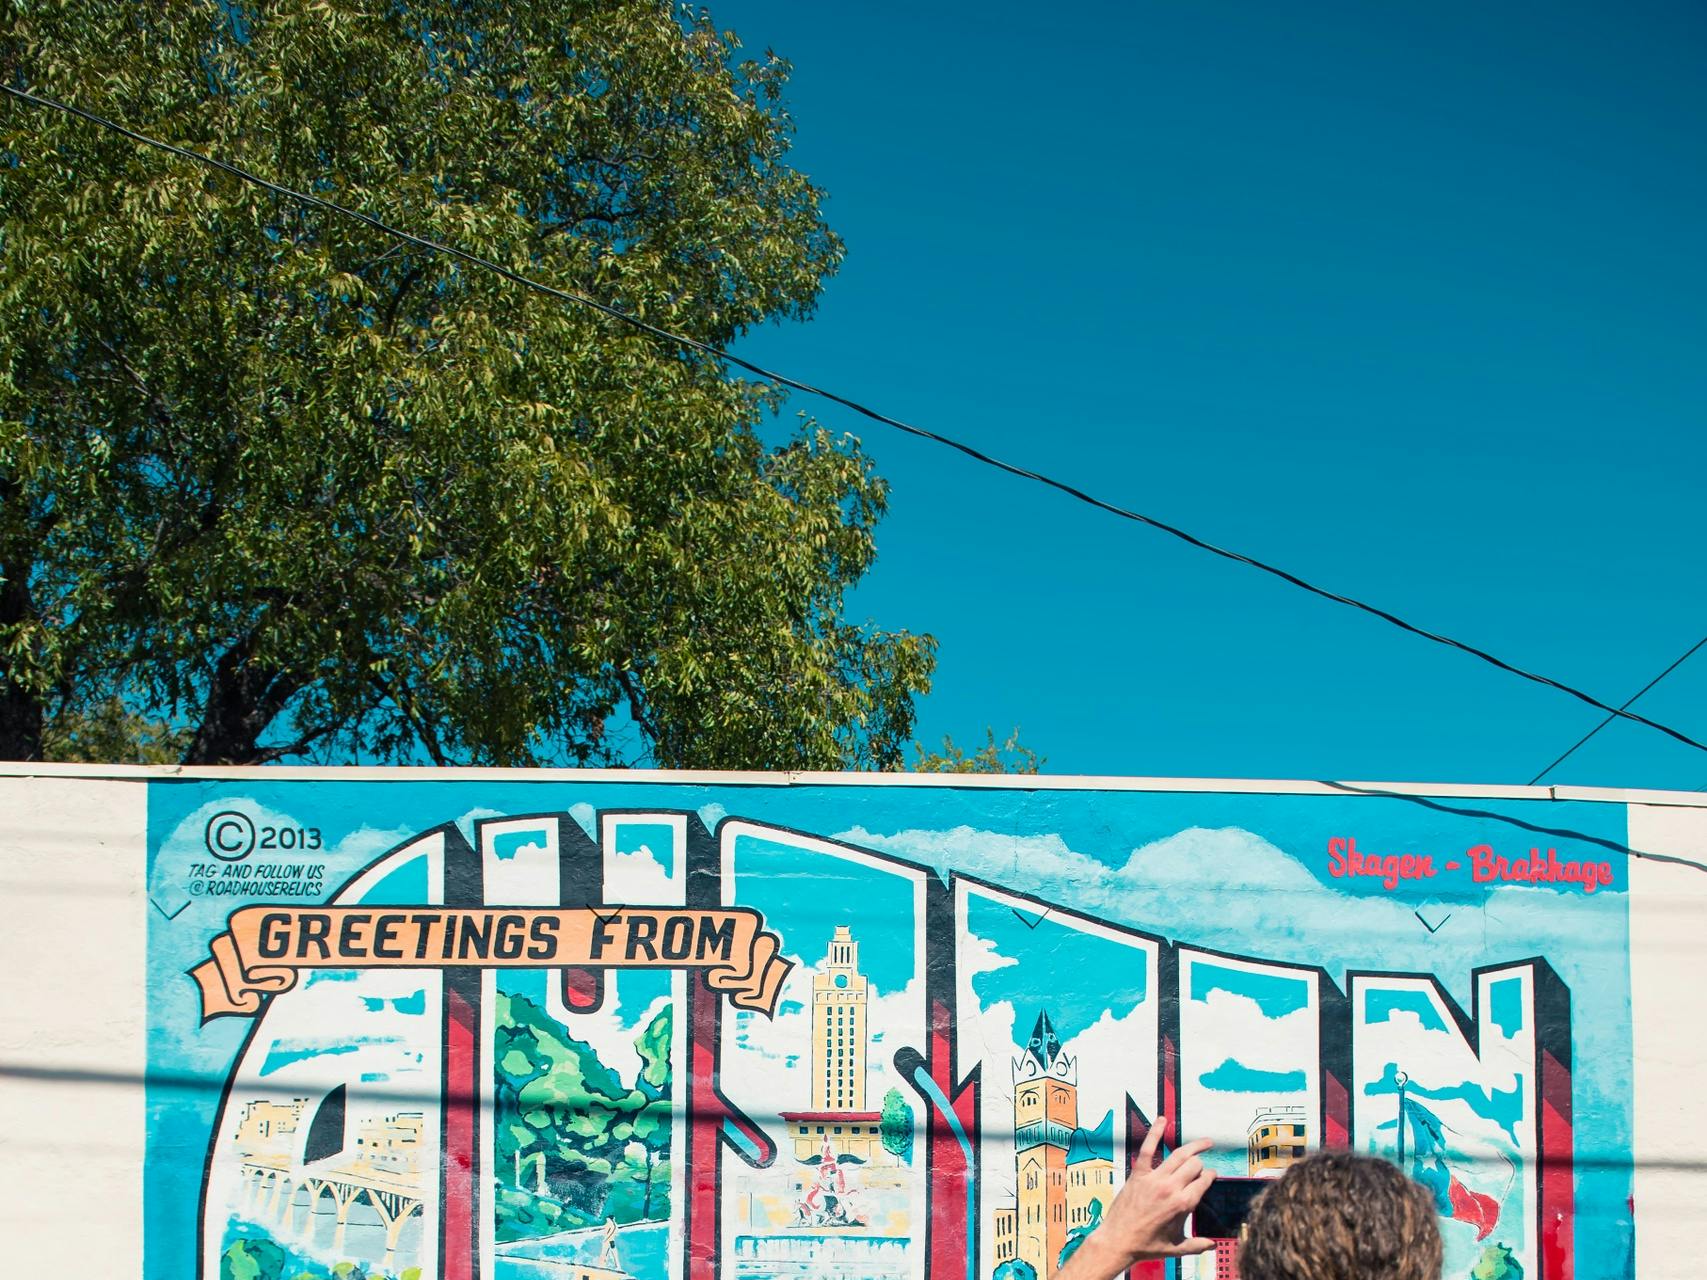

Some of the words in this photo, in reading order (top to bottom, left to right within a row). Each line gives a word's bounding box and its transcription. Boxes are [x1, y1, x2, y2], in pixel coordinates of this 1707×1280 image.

[188, 864, 217, 878] TAG
[221, 864, 252, 879] AND
[254, 864, 305, 879] FOLLOW
[307, 864, 325, 879] US
[1327, 836, 1438, 890] Skagen
[1466, 844, 1613, 893] Brakhage
[257, 912, 560, 960] GREETINGS
[588, 914, 738, 962] FROM
